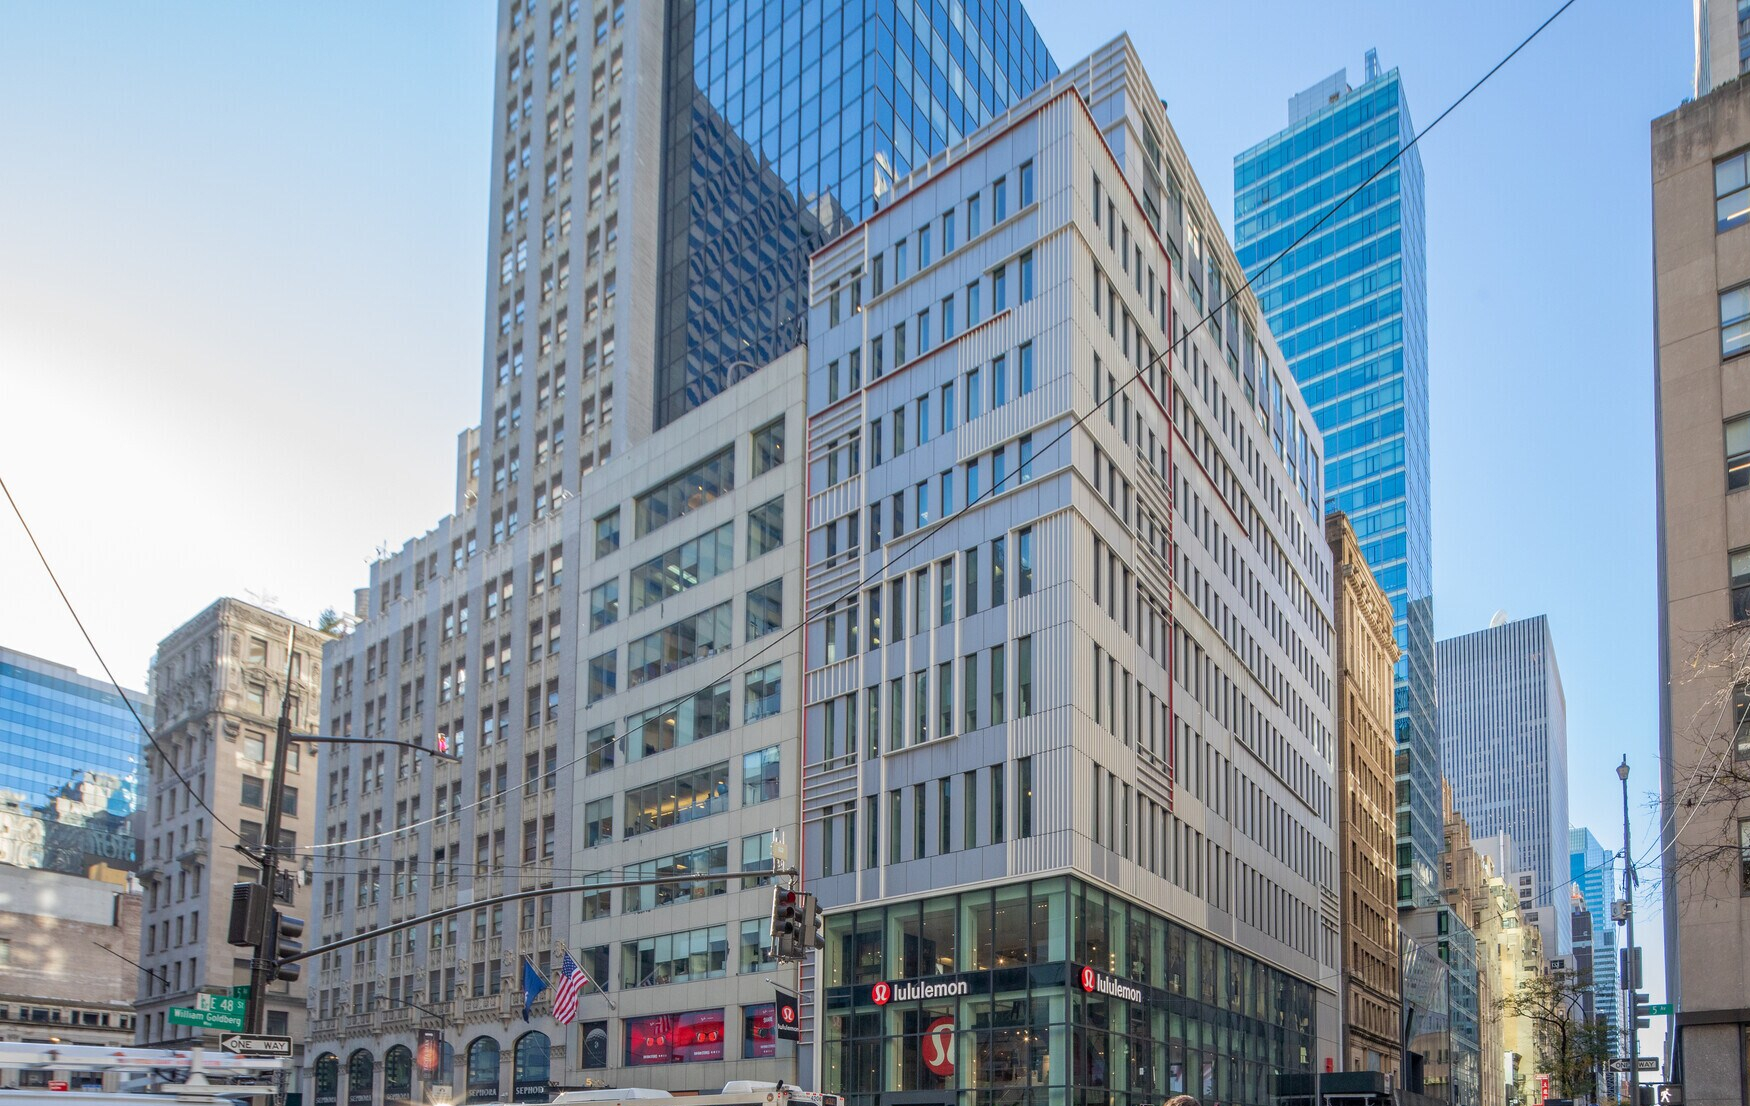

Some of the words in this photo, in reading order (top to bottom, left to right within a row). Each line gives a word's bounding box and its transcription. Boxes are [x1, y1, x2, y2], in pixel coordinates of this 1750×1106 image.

[893, 981, 968, 1001] lululemon
[1097, 973, 1142, 1003] lululemon
[210, 997, 217, 1009] E
[219, 999, 234, 1012] 48
[1652, 1006, 1658, 1015] 5
[173, 1008, 204, 1020] William
[206, 1012, 242, 1027] Goldberg
[777, 1023, 799, 1032] lululemon
[230, 1040, 252, 1049] ONE
[263, 1041, 286, 1050] WAY
[468, 1088, 497, 1097] SEPHORA
